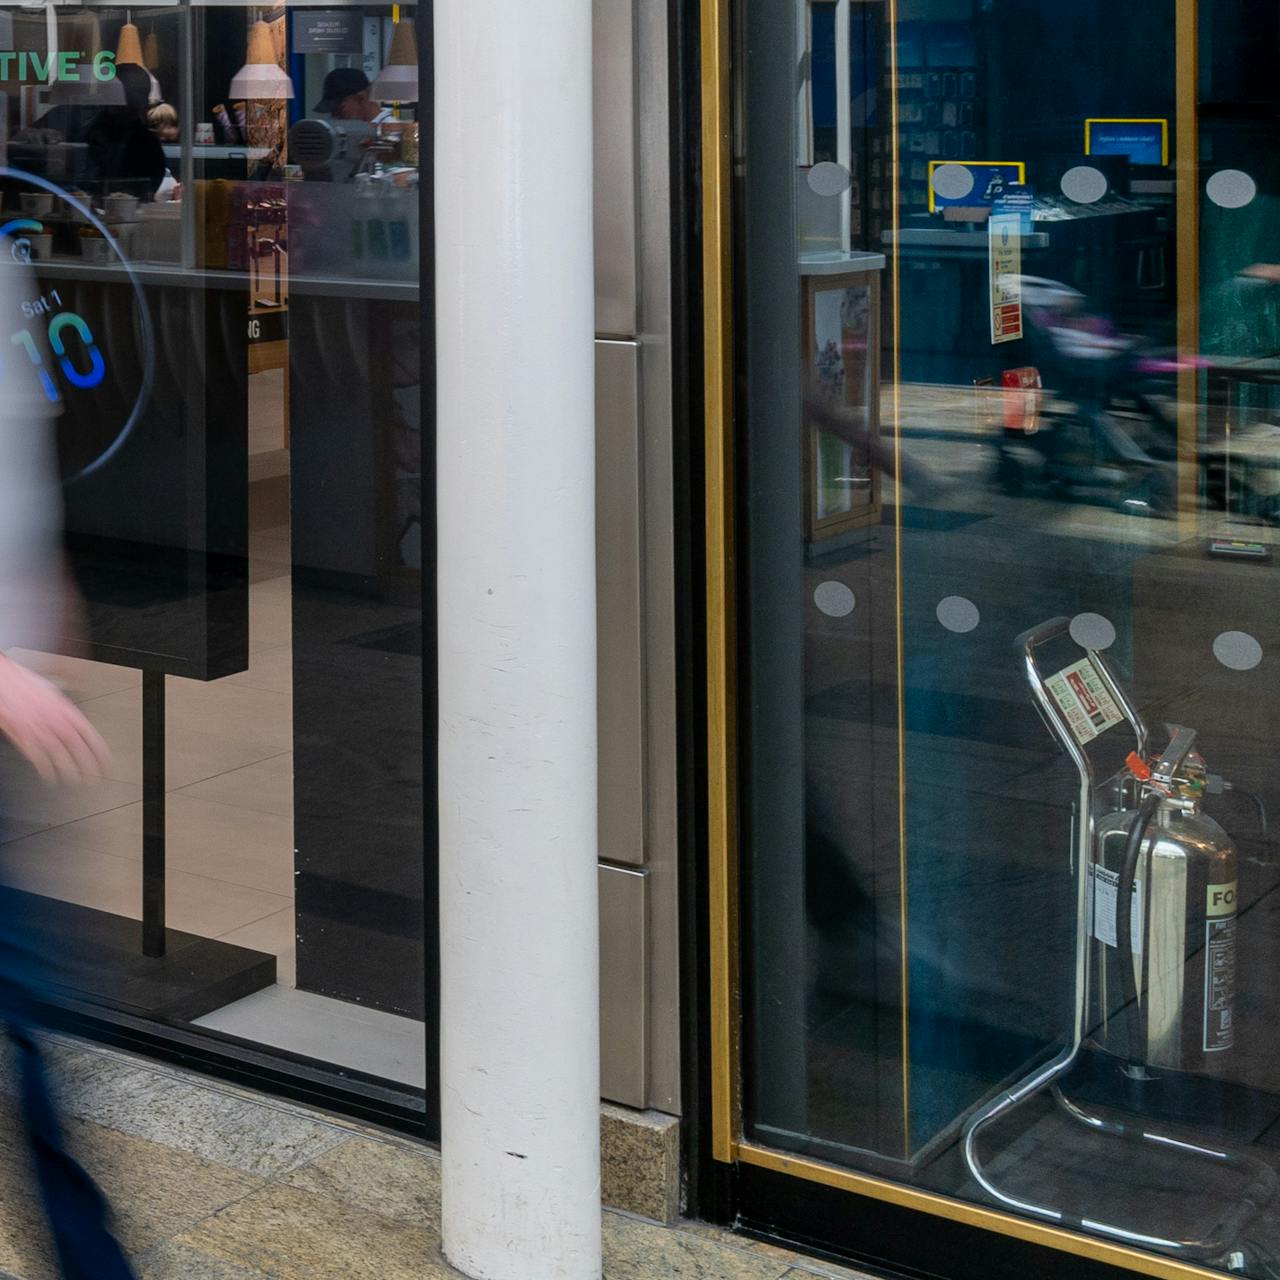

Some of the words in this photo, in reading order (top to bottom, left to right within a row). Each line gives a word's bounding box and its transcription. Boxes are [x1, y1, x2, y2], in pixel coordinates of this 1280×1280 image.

[93, 50, 118, 83] 6
[20, 297, 51, 319] Sat
[51, 289, 63, 306] 1
